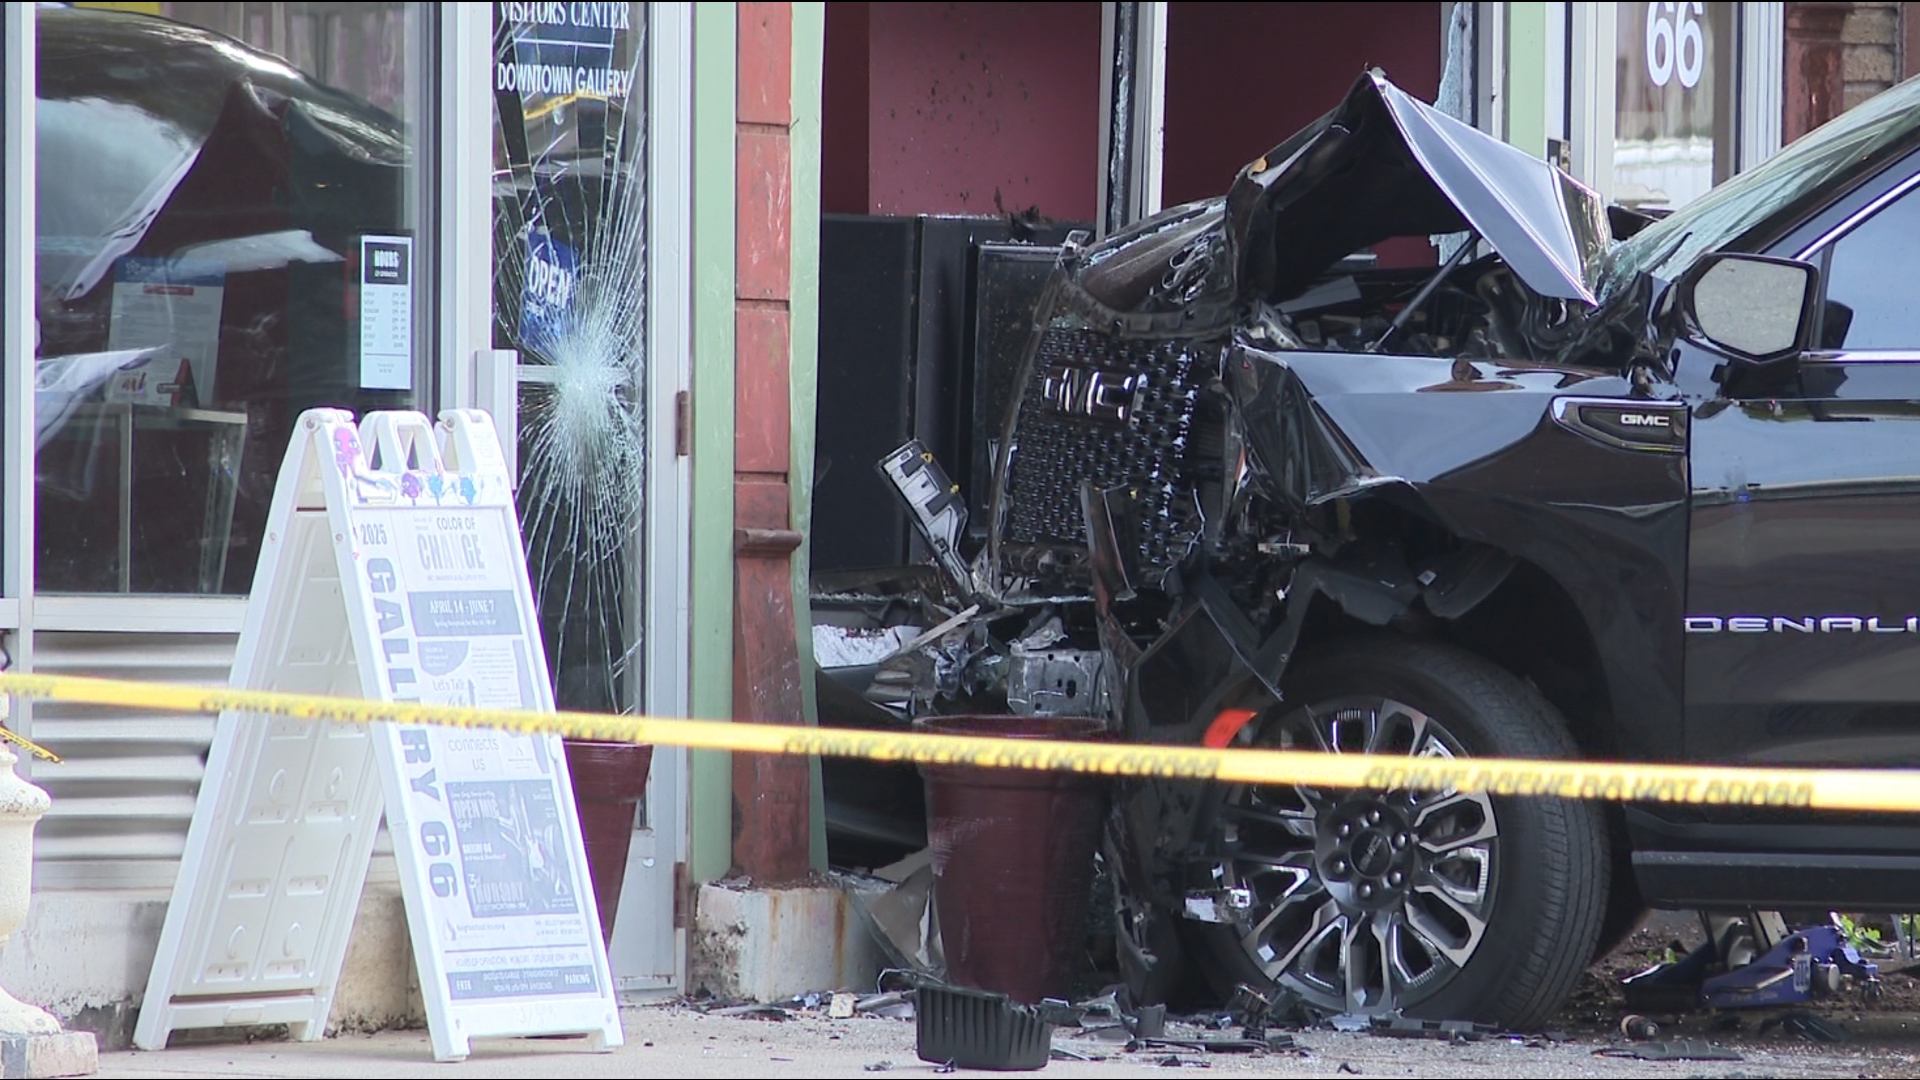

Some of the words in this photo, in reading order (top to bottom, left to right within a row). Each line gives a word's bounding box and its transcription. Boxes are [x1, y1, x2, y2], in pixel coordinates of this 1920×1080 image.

[500, 2, 566, 26] VISITORS
[570, 2, 630, 30] CENTER
[1647, 2, 1703, 88] 66
[497, 62, 572, 94] DOWNTOWN
[575, 66, 629, 98] GALLERY
[528, 255, 572, 310] OPEN
[1620, 413, 1670, 427] GMC
[360, 524, 388, 546] 2025
[436, 516, 463, 531] COLOR
[464, 516, 476, 530] OF
[416, 533, 486, 570] CHANGE
[429, 600, 453, 614] APRIL
[453, 600, 464, 614] 14
[468, 600, 487, 616] JUNE
[488, 599, 495, 613] 7
[1683, 616, 1919, 634] DENALI
[366, 557, 441, 802] GALLRY
[420, 821, 459, 898] 66
[448, 738, 499, 752] connects
